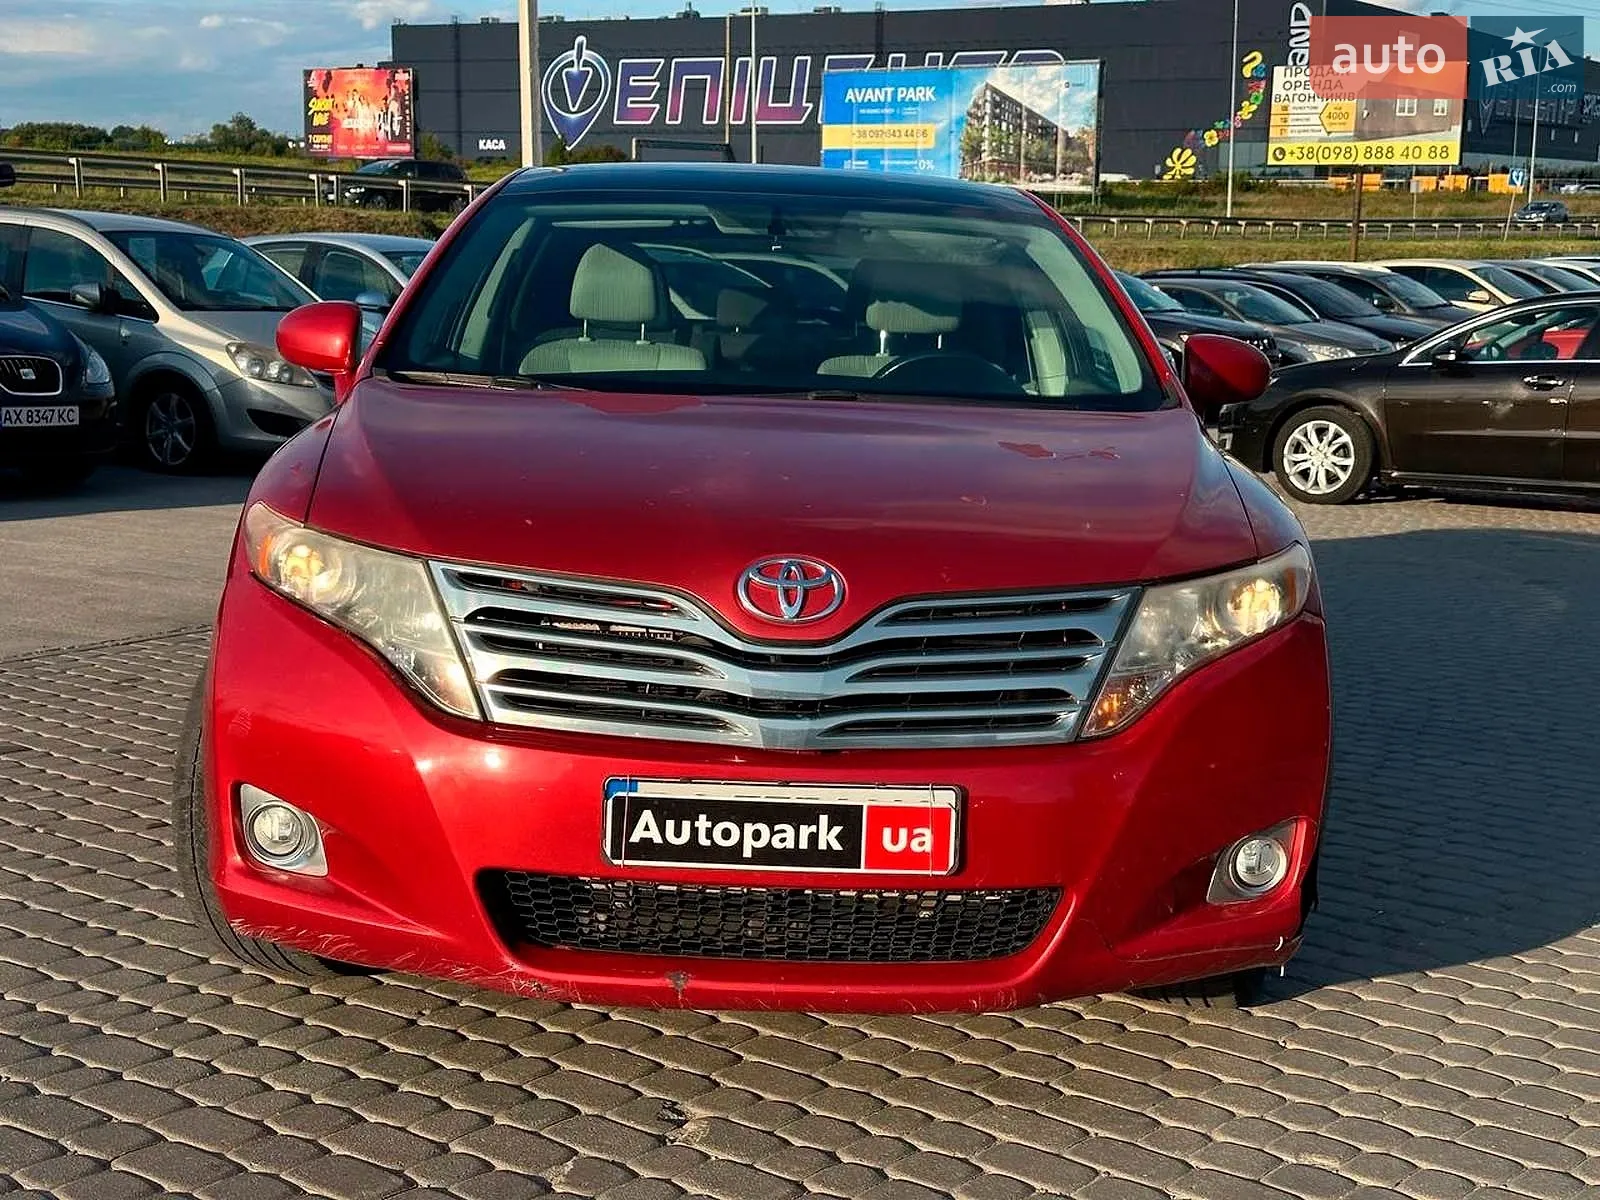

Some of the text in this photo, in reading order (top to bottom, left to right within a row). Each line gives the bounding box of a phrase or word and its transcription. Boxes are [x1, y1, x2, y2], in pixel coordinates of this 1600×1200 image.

[1283, 66, 1350, 79] ПРОДА
[1282, 80, 1344, 92] ОРЕНДА
[844, 86, 936, 103] AVANT PARK
[1273, 92, 1356, 103] ВАГОНЧИКІВ
[1325, 111, 1350, 120] 4000
[478, 139, 506, 150] КАСА
[1288, 145, 1450, 163] +38(098) 888 40 88
[3, 408, 75, 425] AX 8347 KC
[629, 809, 932, 858] Autopark ua
